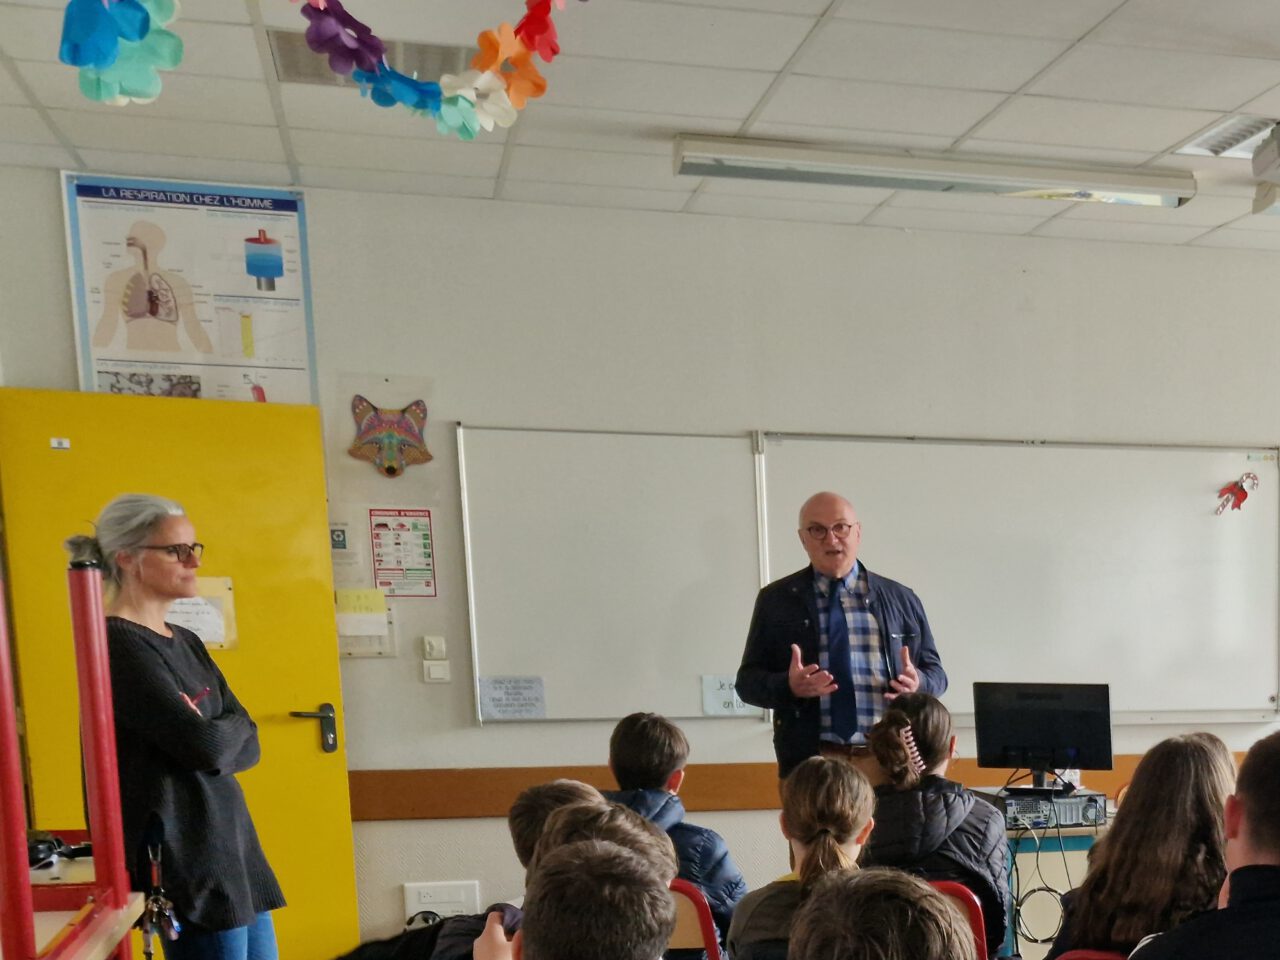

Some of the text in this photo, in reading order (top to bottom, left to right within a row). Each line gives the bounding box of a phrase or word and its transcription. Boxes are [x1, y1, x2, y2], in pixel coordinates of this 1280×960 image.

[102, 188, 273, 209] LA RESPIRATION CHEZ L'HOMME
